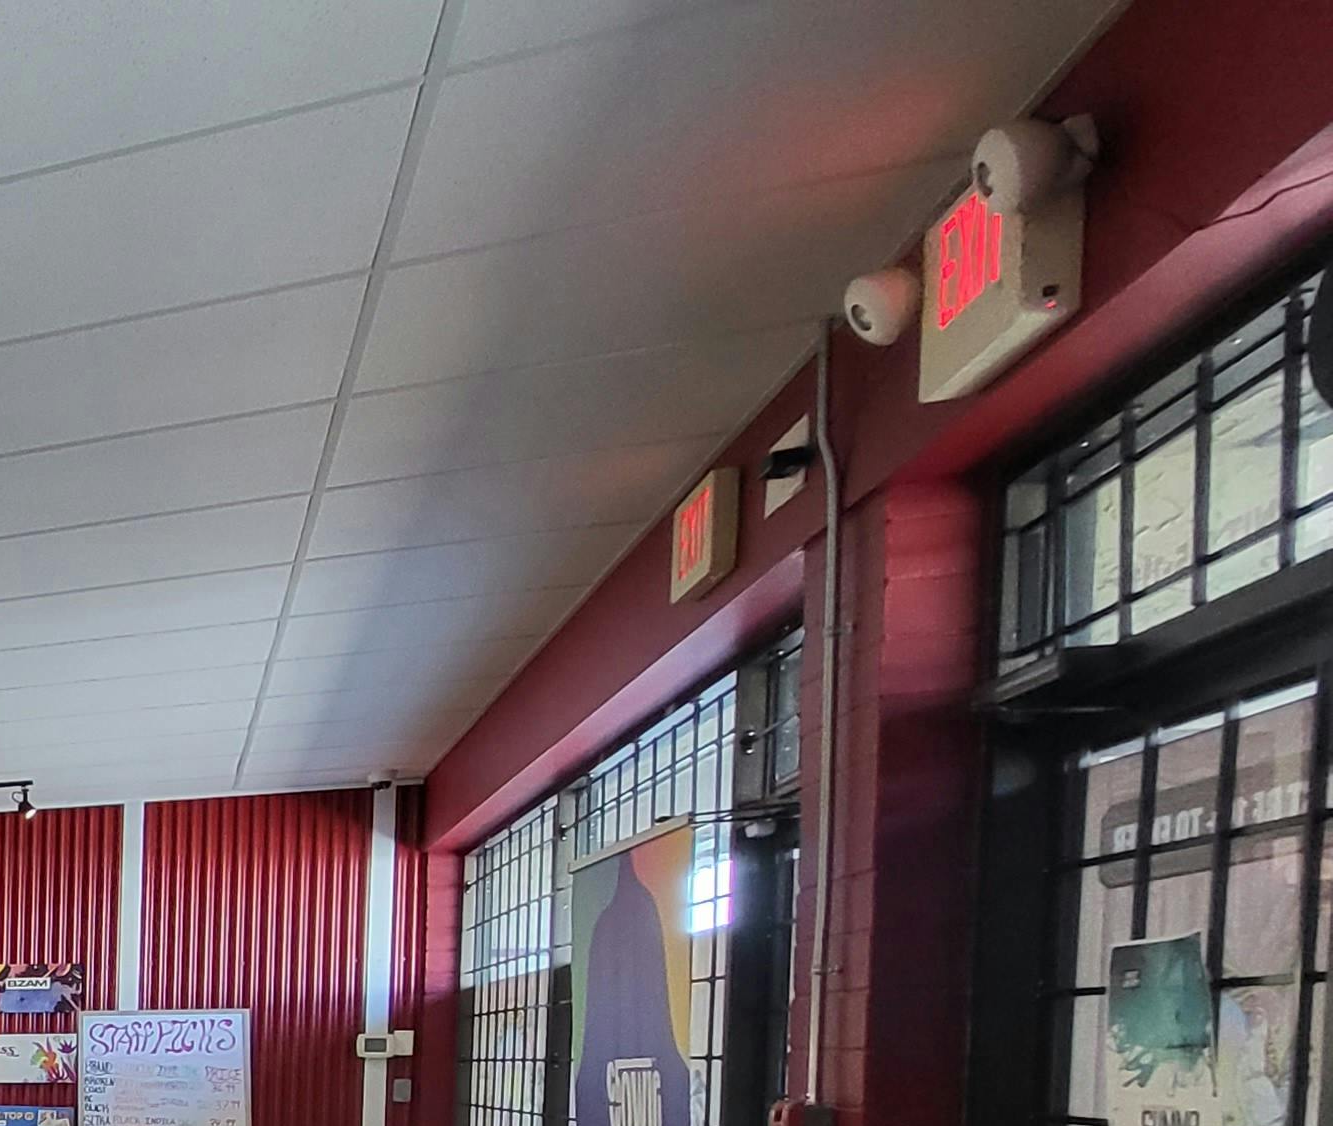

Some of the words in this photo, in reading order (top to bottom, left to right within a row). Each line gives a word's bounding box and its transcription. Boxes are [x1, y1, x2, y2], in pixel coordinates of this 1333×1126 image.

[678, 486, 710, 582] EXIT
[7, 980, 48, 988] BZAM
[89, 1021, 154, 1055] STAFF
[150, 1019, 236, 1055] PICKS
[3, 1111, 23, 1120] TOP
[145, 1116, 176, 1125] INDICA
